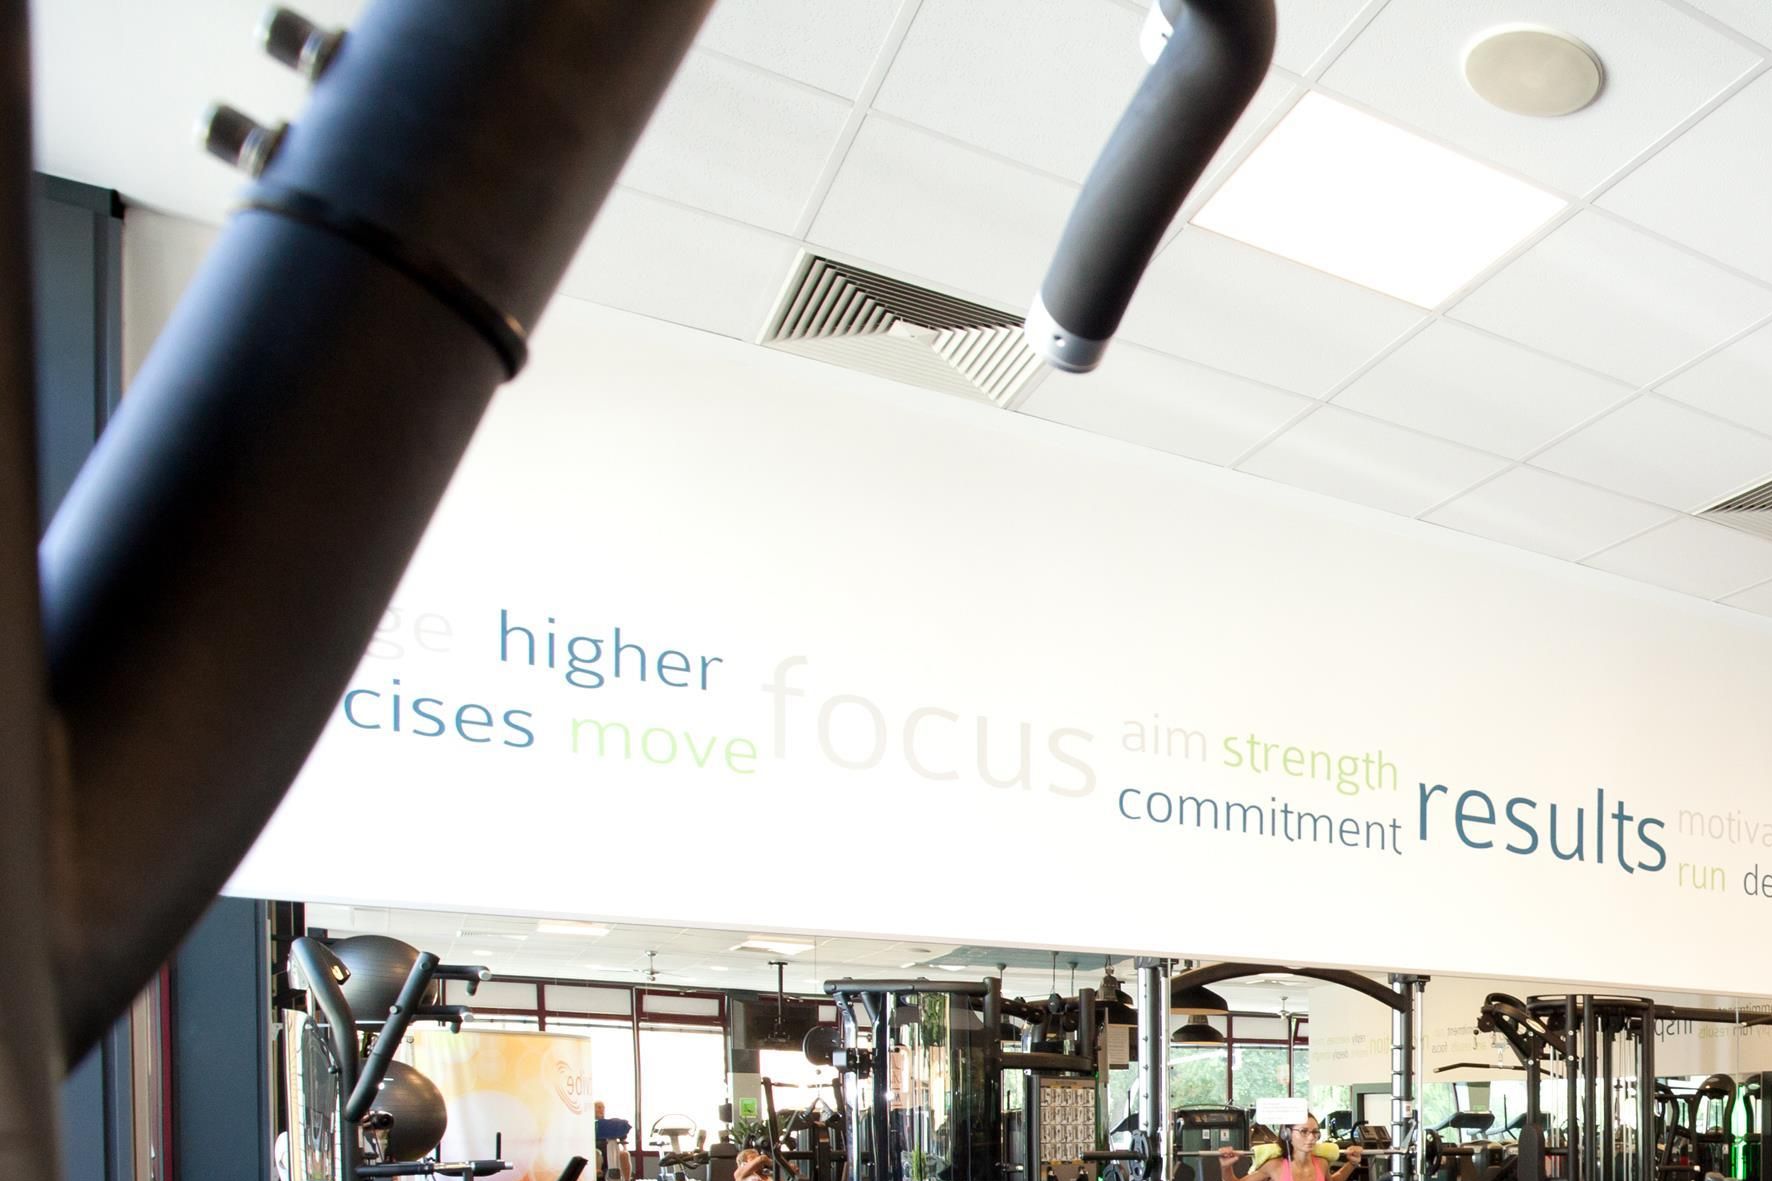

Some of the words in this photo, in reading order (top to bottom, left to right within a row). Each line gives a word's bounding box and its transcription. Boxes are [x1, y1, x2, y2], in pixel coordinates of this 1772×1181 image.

[500, 609, 723, 690] higher
[570, 716, 758, 775] move
[761, 655, 1098, 799] focus
[1121, 713, 1208, 763] aim
[1222, 732, 1398, 796] strength
[1118, 787, 1402, 855] commitment
[1417, 781, 1668, 874] results
[1679, 862, 1726, 892] run
